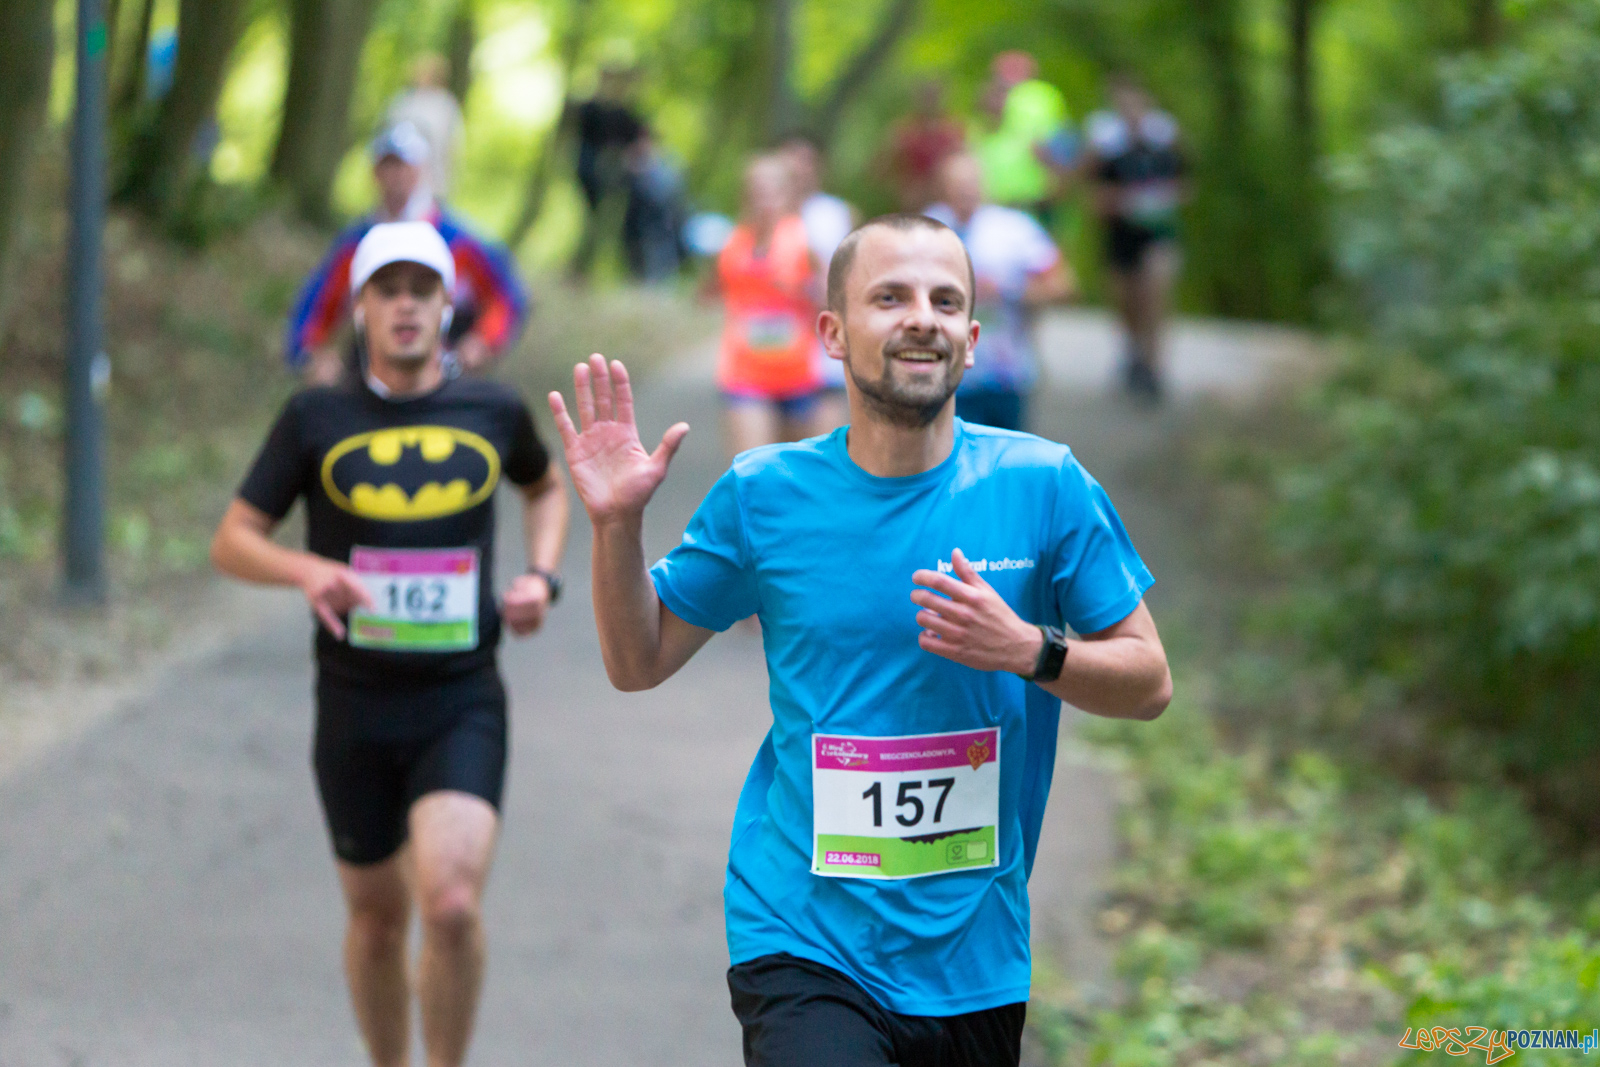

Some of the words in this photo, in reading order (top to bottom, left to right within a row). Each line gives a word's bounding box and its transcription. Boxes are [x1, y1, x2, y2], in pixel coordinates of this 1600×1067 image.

[386, 578, 449, 620] 162
[879, 748, 956, 760] BIEGCZEKOLADOWY.PL
[862, 777, 956, 827] 157
[827, 853, 878, 864] 22.06.2018
